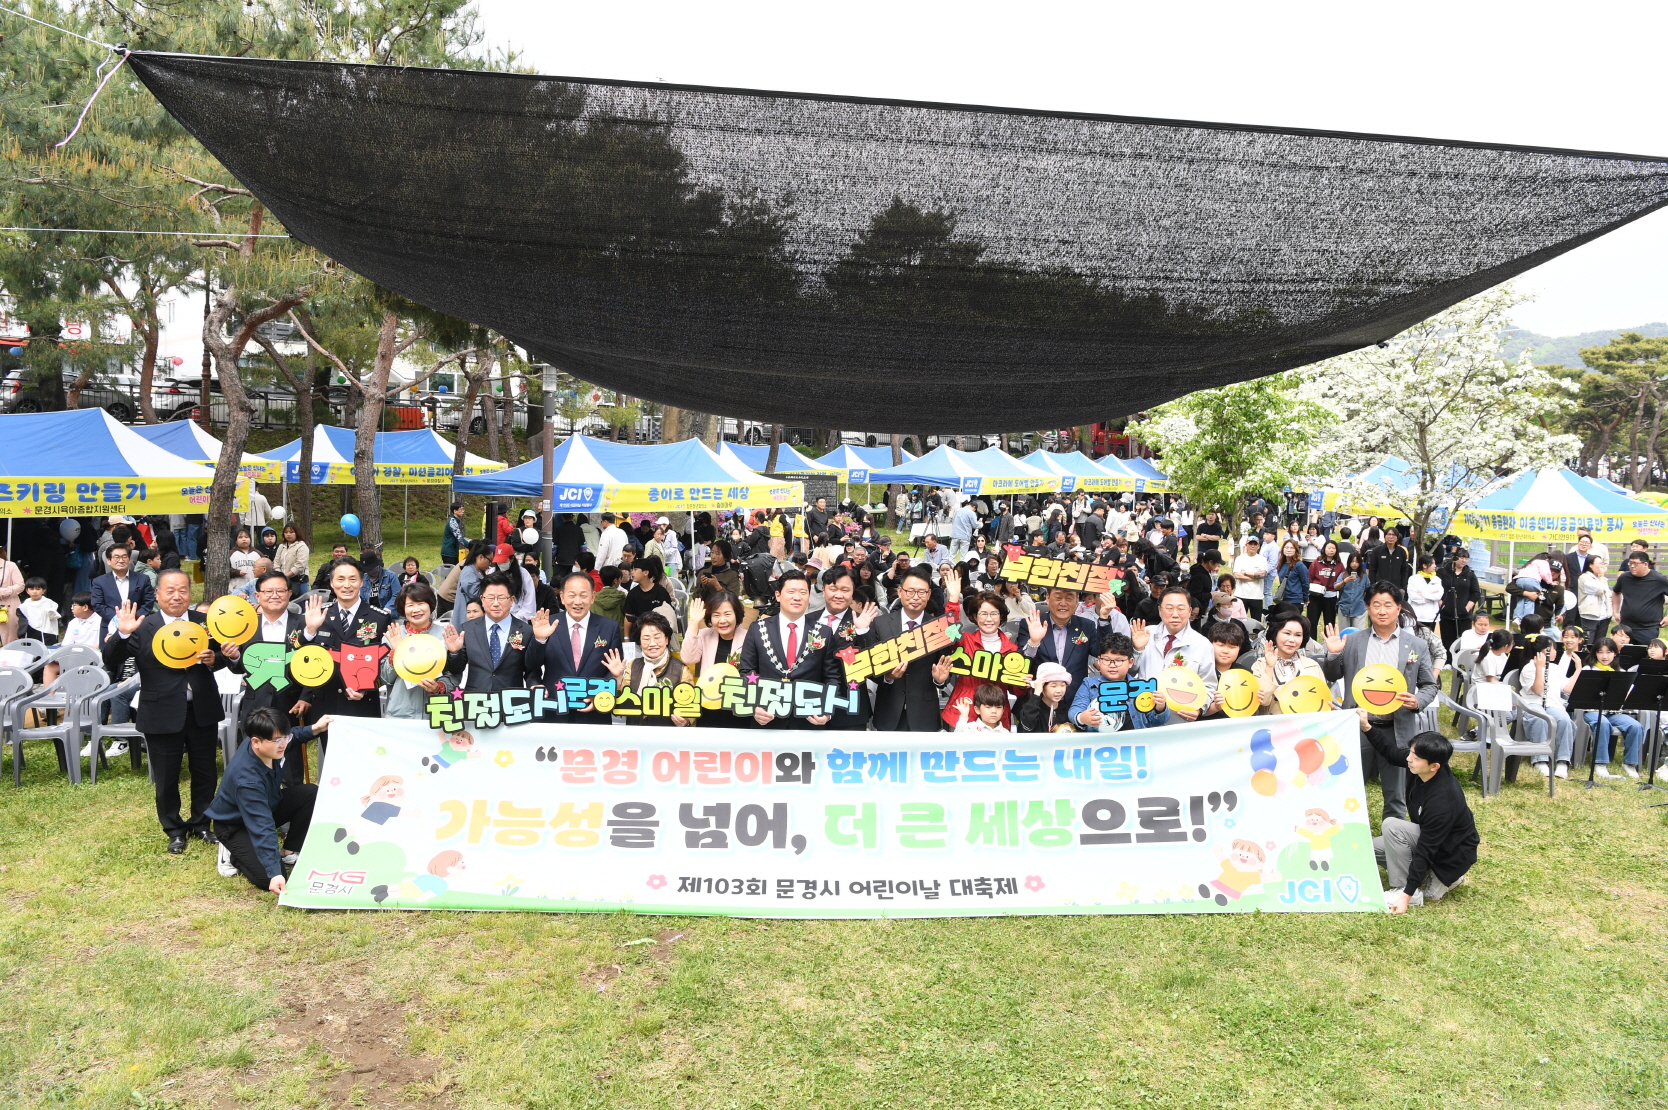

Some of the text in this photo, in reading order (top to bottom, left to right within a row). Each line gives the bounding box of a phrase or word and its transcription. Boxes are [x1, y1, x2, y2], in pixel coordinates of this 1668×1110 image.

[76, 482, 147, 503] 만들기
[181, 485, 203, 496] 오늘은
[188, 495, 209, 505] 어린이
[559, 487, 583, 501] JCI
[648, 486, 750, 502] 종이로 만드는 세상
[34, 505, 126, 515] 문경시육아종합지원센터
[1491, 514, 1516, 530] 응급환자
[1606, 517, 1624, 532] 봉사
[1000, 555, 1117, 595] 무한친절
[843, 617, 957, 683] 무한친절
[949, 646, 1031, 688] 스마일
[560, 677, 617, 713] 문경
[613, 683, 702, 718] 스마일
[720, 678, 859, 717] 친절도시
[1098, 678, 1157, 713] 문경
[426, 686, 568, 733] 친절도시
[651, 749, 815, 785] 어린이와
[826, 748, 908, 784] 함께
[920, 749, 1041, 783] 만드는
[1053, 745, 1148, 781] 내일!
[435, 800, 660, 849] 가능성을
[678, 801, 807, 855] 넘어,
[824, 801, 877, 849] 더
[895, 801, 948, 849] 큰
[309, 870, 366, 885] MG
[311, 882, 354, 896] 문경시
[677, 876, 1019, 900] 제103회 문경시 어린이날 대축제
[1279, 879, 1332, 904] JCI
